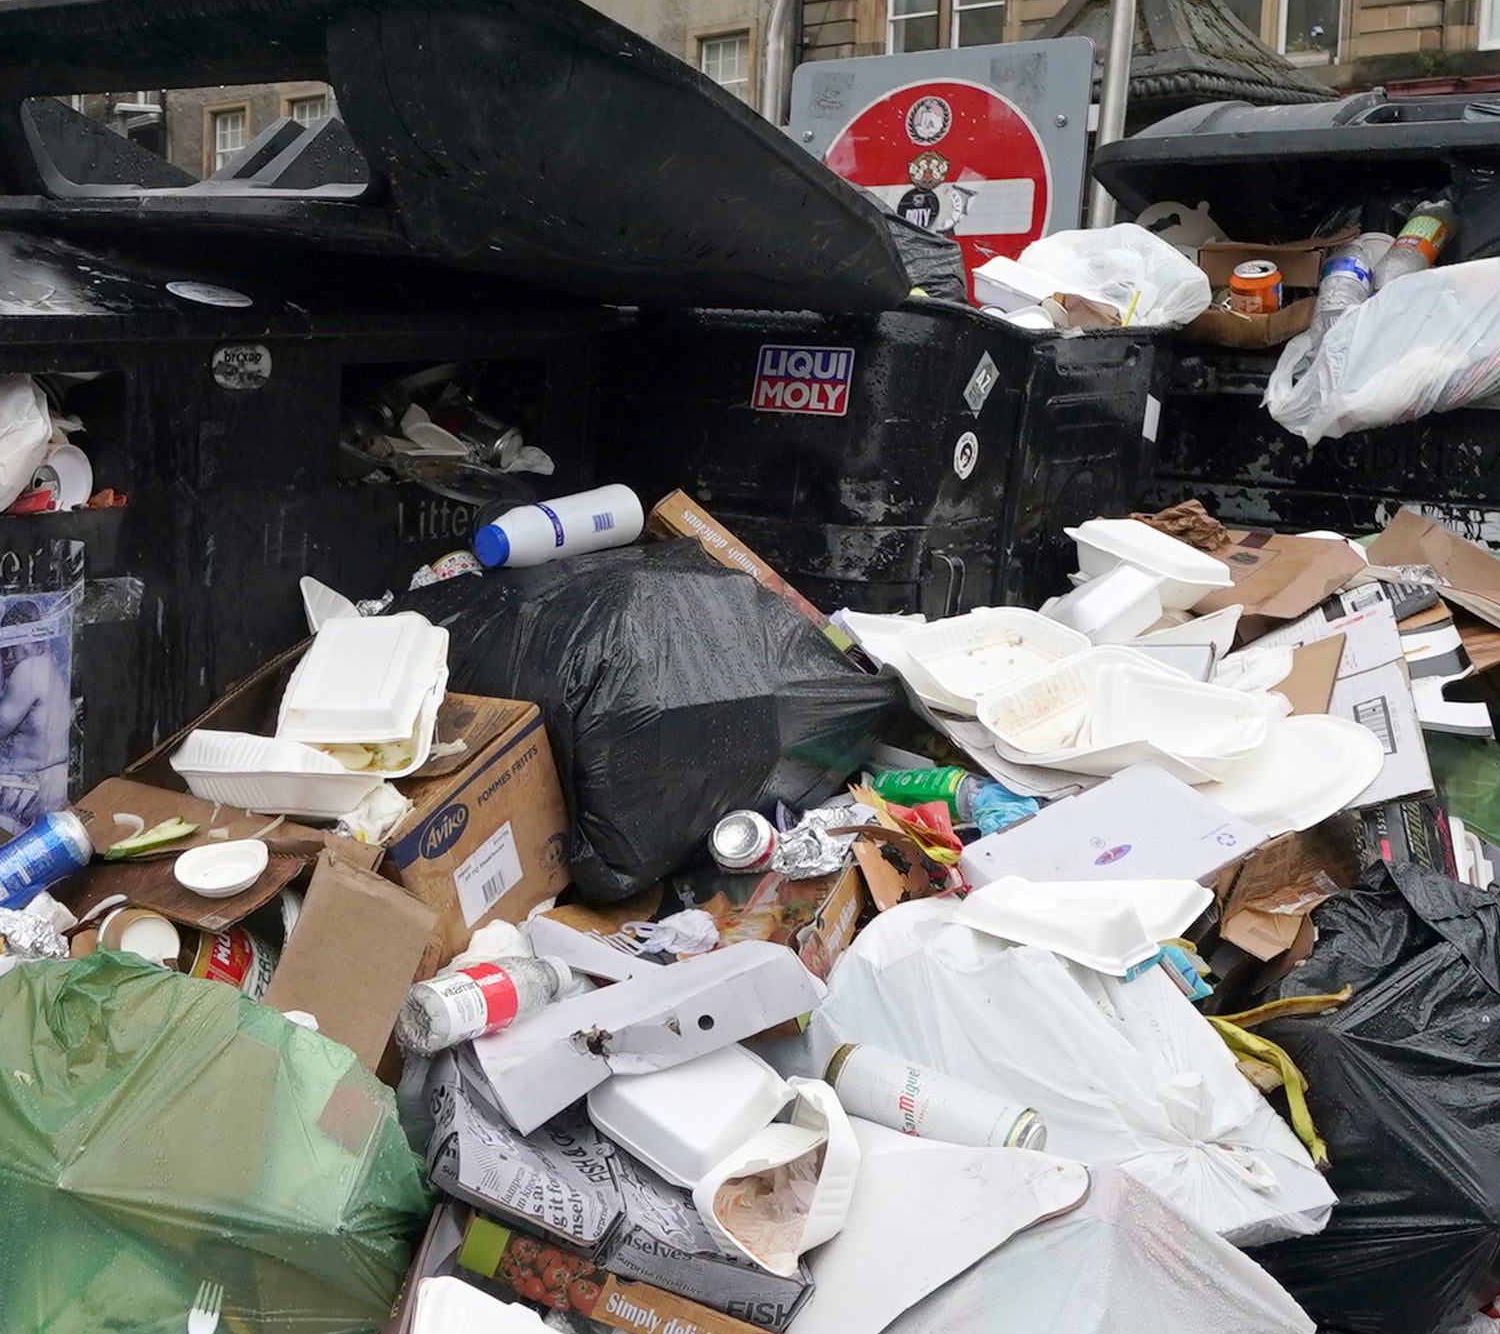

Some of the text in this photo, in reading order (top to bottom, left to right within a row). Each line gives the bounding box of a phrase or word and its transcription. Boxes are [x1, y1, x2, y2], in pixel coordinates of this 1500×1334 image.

[763, 350, 849, 381] LIQUI
[757, 380, 846, 412] MOLY
[679, 509, 763, 579] delicious Simply
[476, 744, 539, 807] POMMES FRITES
[424, 806, 467, 858] Aviko
